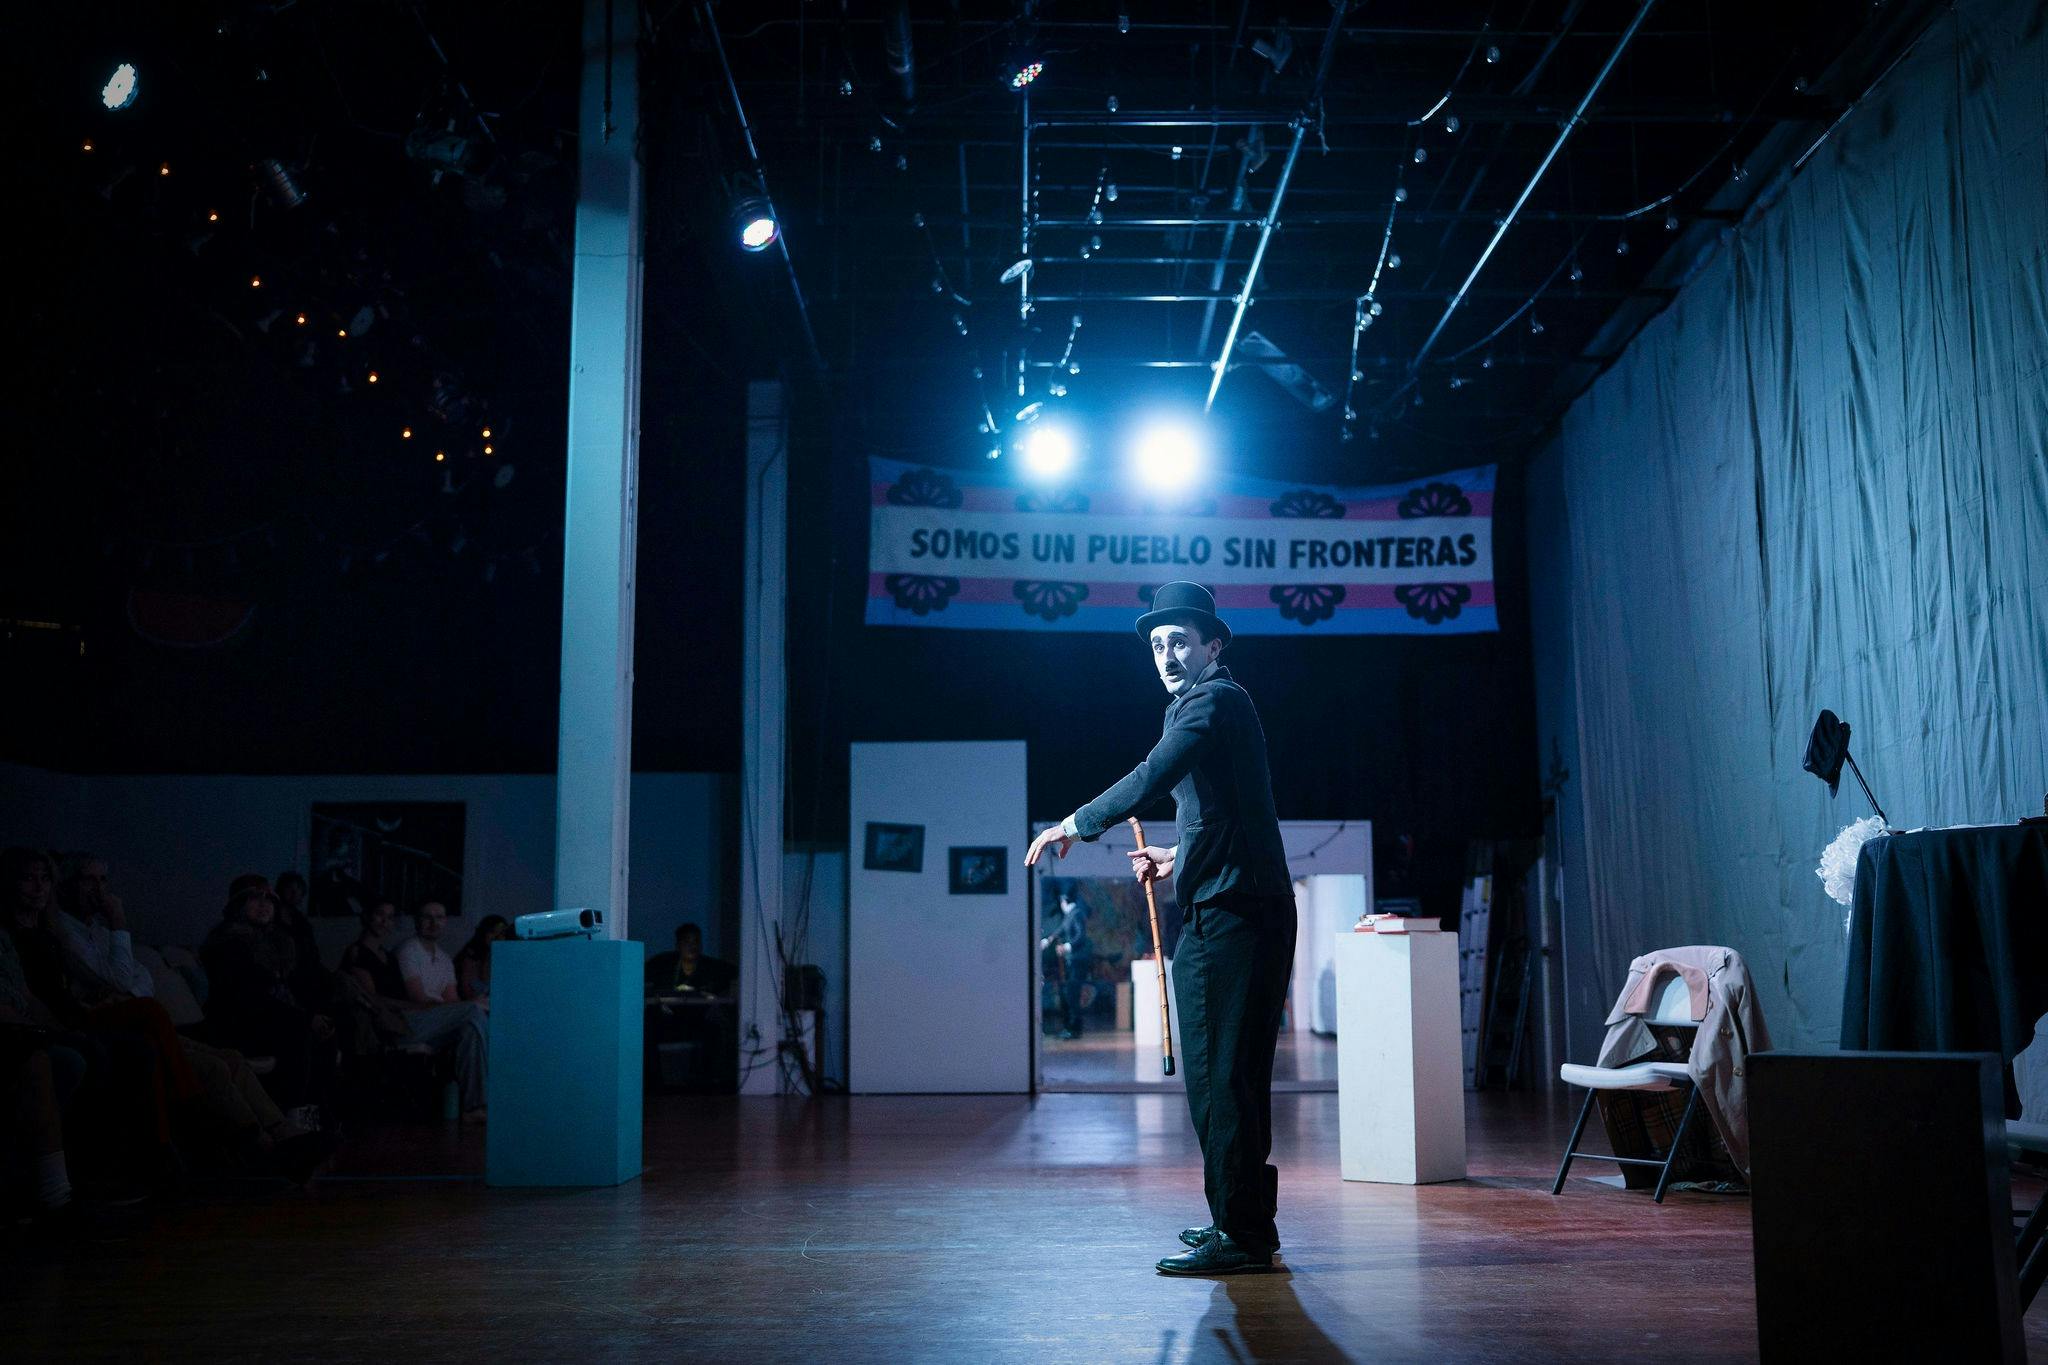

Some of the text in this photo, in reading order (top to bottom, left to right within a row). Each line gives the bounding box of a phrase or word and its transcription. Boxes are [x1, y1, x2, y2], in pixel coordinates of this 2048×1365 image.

[910, 529, 1477, 569] SOMOS UN PUEBLO SIN FRONTERAS
